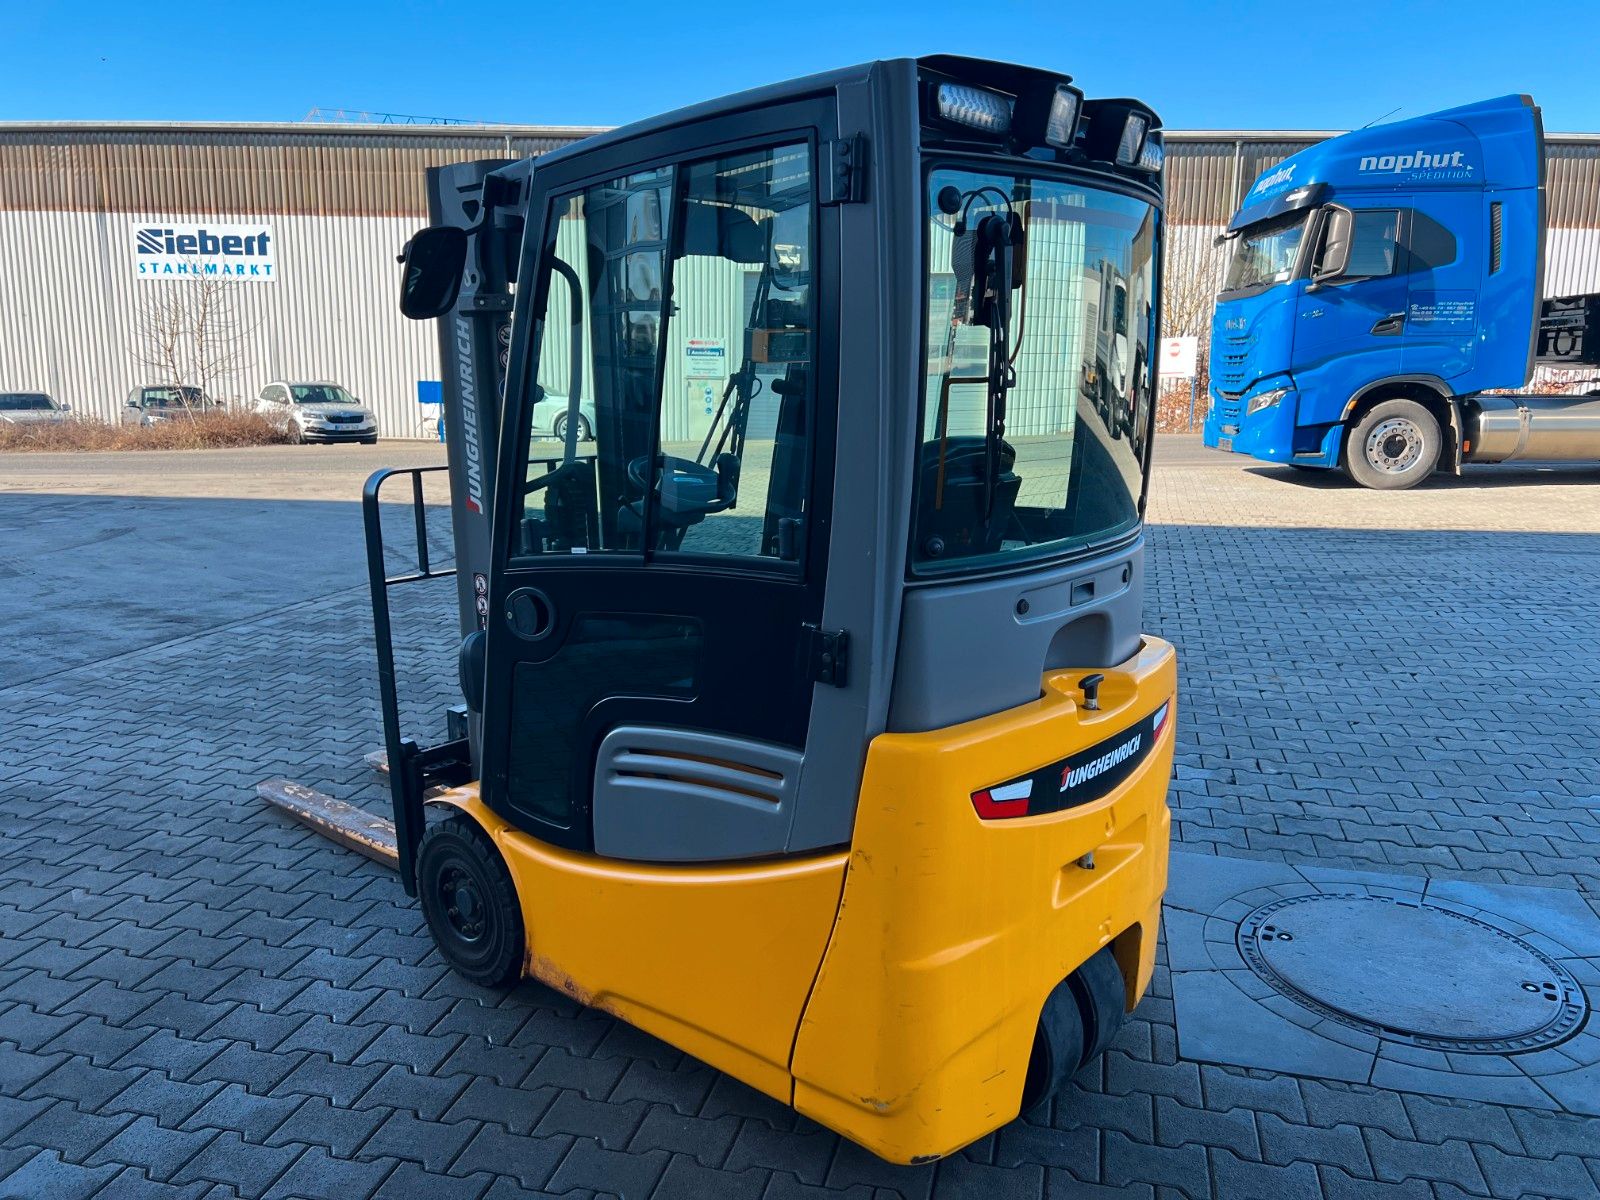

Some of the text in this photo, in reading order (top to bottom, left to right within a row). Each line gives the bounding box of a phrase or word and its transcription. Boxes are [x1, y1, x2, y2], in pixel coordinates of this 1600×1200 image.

[1358, 150, 1465, 174] nophut
[1410, 171, 1473, 180] SPEDITION
[136, 228, 271, 256] Siebert
[139, 262, 273, 276] STAHLMARKT
[456, 317, 484, 515] JUNGHEINRICH
[1059, 733, 1142, 793] JUNGHEINRICH
